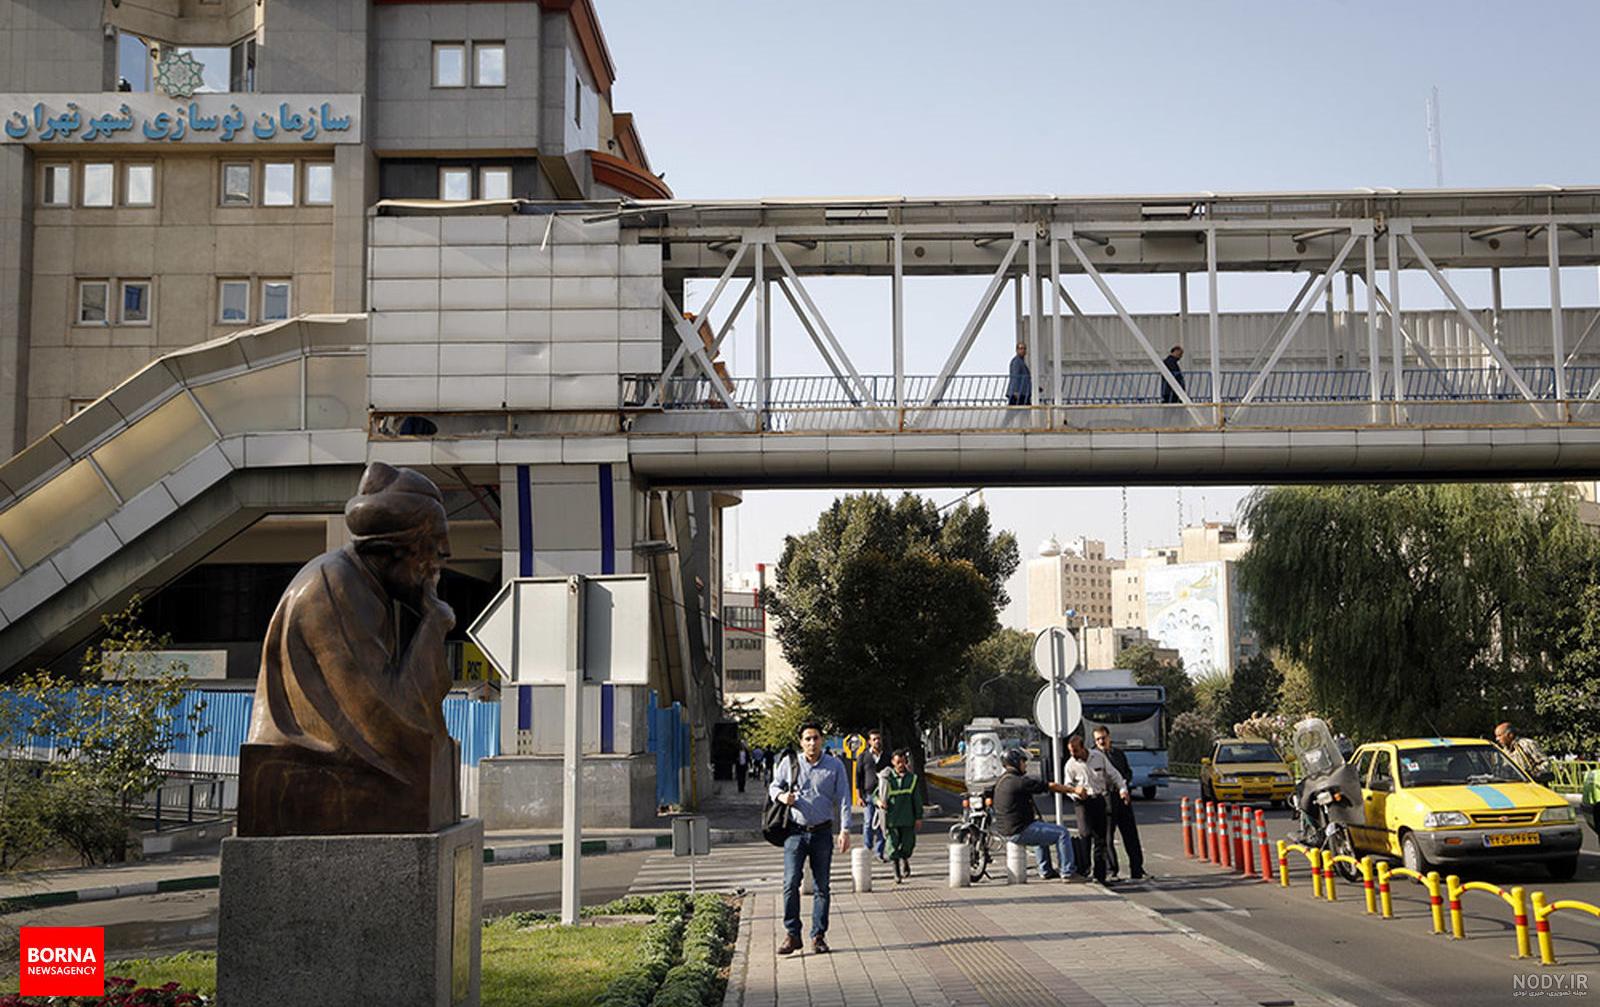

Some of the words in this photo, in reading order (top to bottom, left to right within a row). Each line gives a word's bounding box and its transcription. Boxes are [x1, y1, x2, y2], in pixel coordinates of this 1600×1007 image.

[5, 102, 81, 141] تهران
[83, 103, 134, 140] شهر
[143, 102, 244, 141] نوسازی
[252, 103, 351, 140] سازمان
